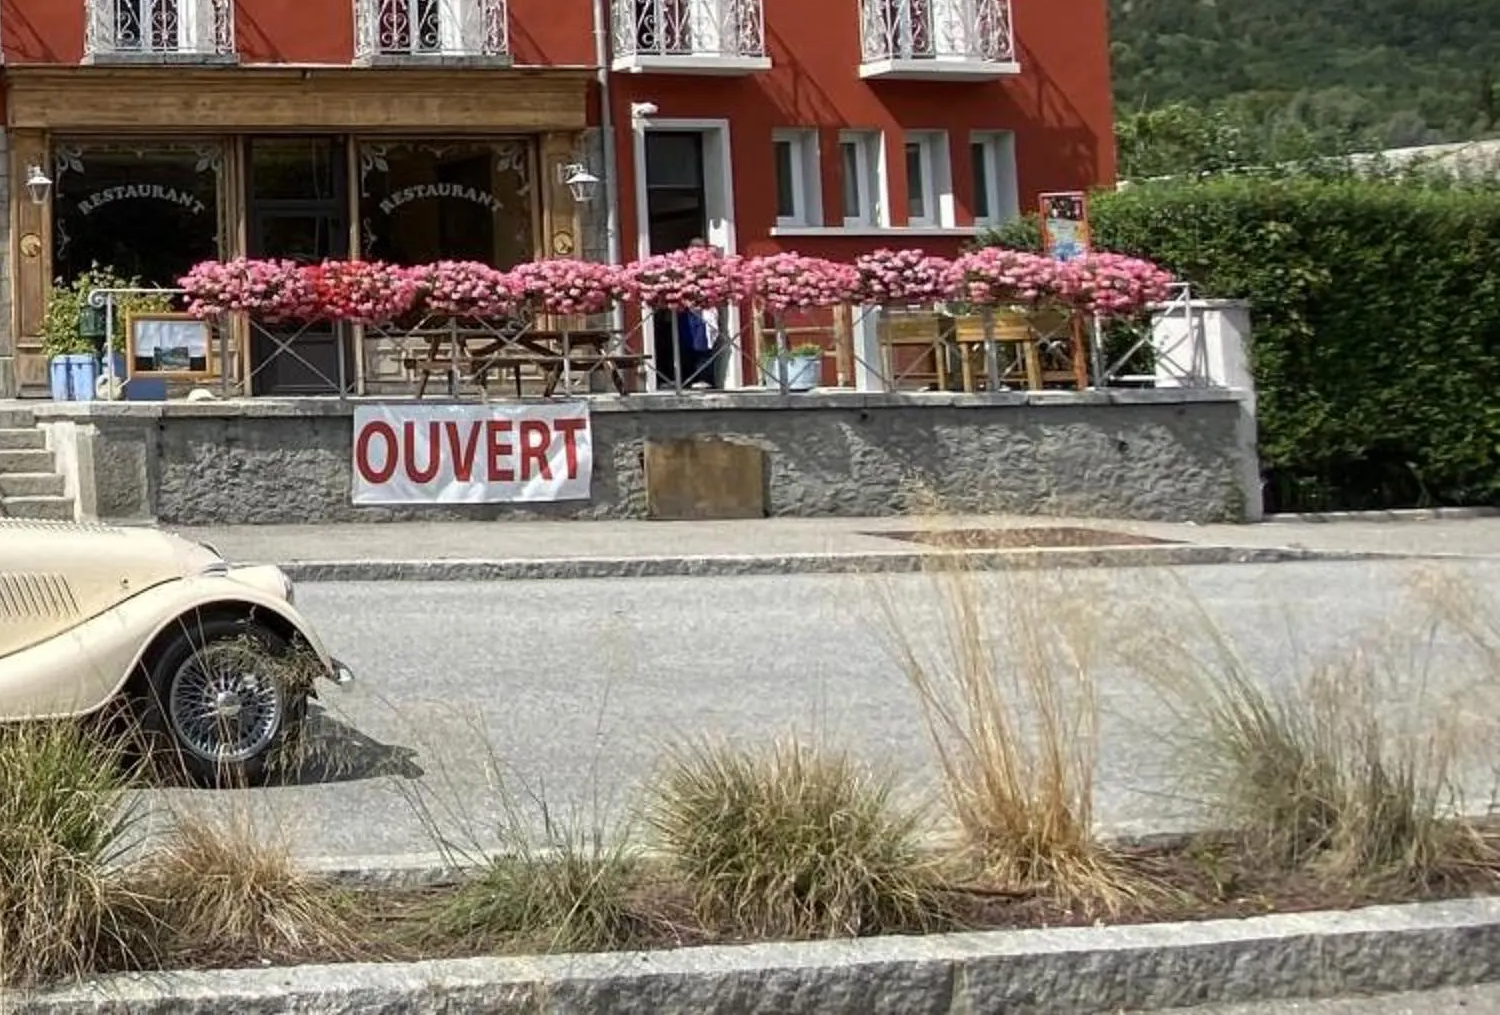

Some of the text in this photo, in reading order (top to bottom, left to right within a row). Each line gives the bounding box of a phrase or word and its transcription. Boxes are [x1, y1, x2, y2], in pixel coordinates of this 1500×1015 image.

[78, 184, 205, 215] RESTAURANT
[380, 183, 504, 215] RESTAURANT
[356, 418, 587, 483] OUVERT
